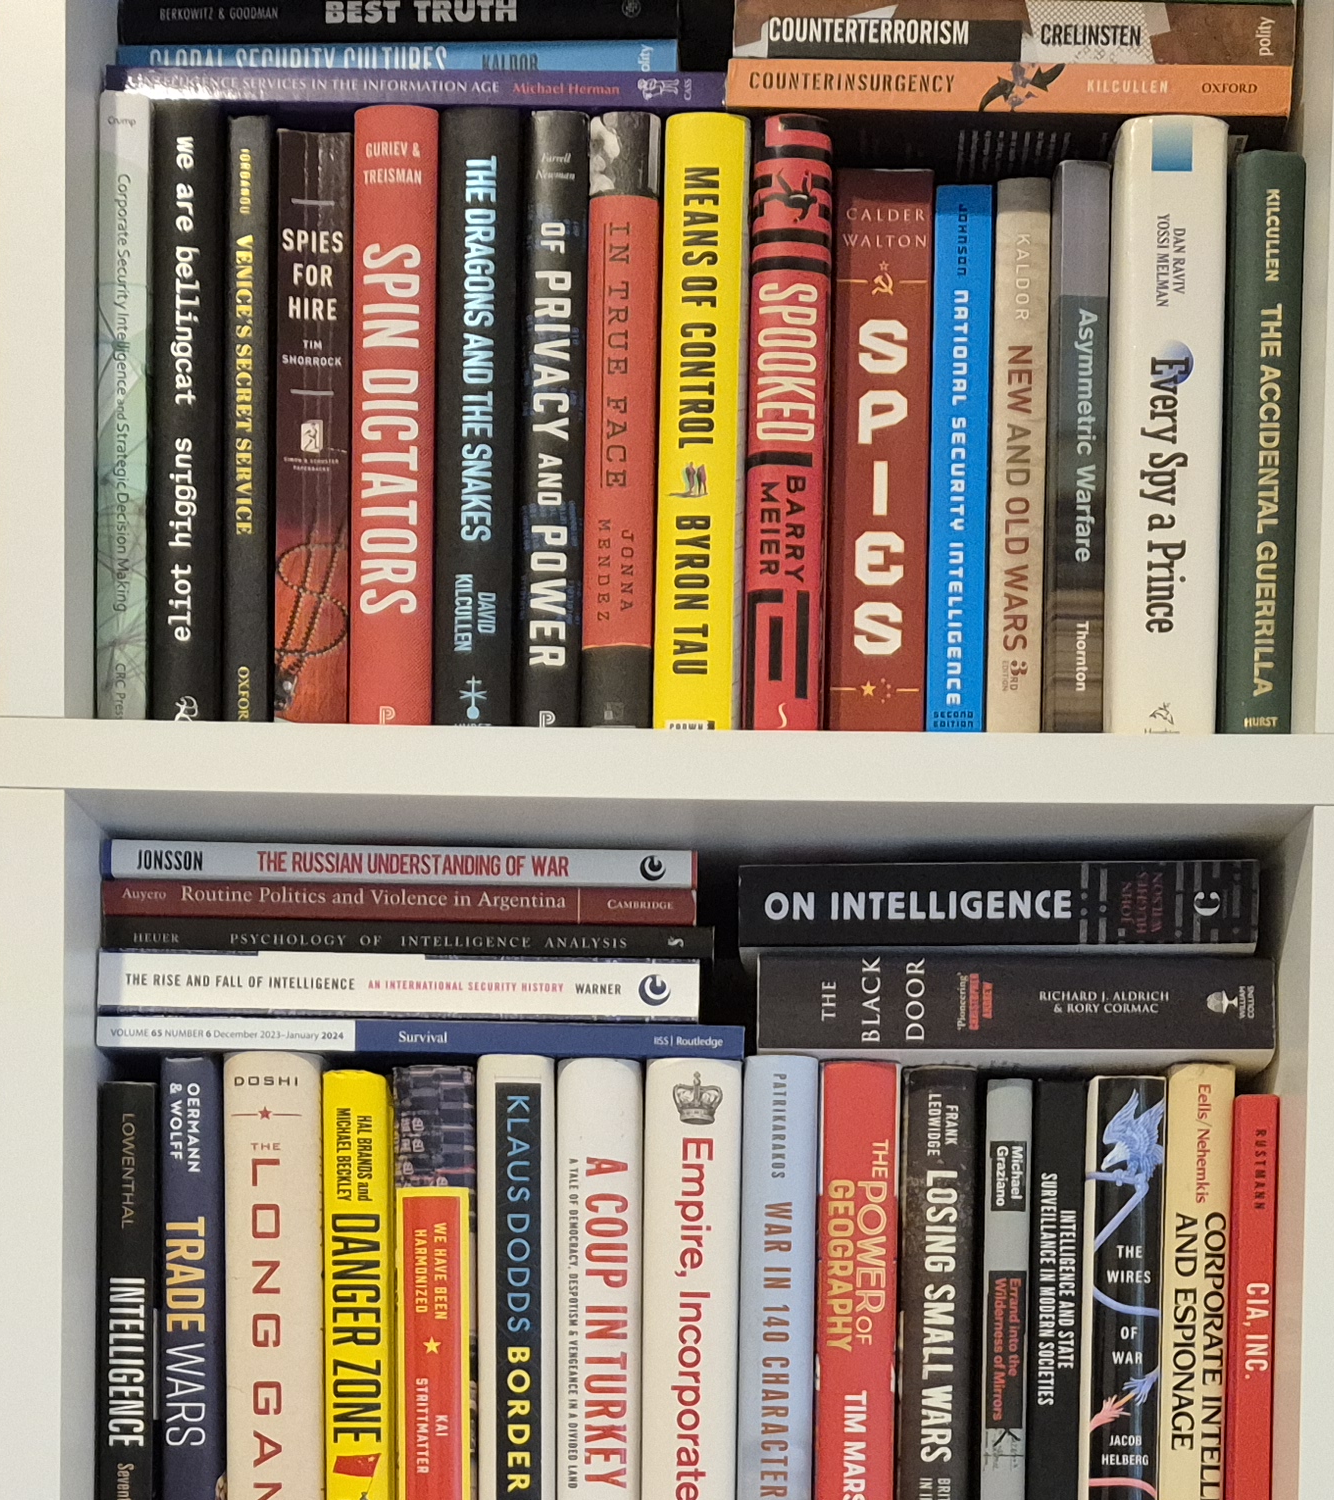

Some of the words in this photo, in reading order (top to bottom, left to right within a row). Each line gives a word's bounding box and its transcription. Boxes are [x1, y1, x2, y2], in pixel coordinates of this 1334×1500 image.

[768, 17, 968, 45] COUNTERTERRORISM
[1041, 24, 1141, 46] CRELINSTEN
[1258, 17, 1275, 56] polity
[750, 72, 954, 92] COUNTERINSURGENCY
[1087, 80, 1167, 93] KILCULLEN
[1202, 83, 1257, 93] OXFORD
[846, 207, 924, 223] CALDER
[283, 229, 343, 253] SPIES
[843, 233, 926, 249] WALTON
[294, 265, 332, 287] FOR
[363, 244, 421, 348] SPIN
[289, 299, 336, 321] HIRE
[360, 369, 418, 614] DICTATORS
[674, 516, 711, 610] BYRON
[673, 624, 708, 675] TAU
[138, 850, 202, 870] JONSSON
[257, 851, 287, 872] THE
[292, 852, 362, 873] RUSSIAN
[368, 853, 501, 876] UNDERSTANDING
[506, 855, 525, 876] OF
[532, 856, 568, 876] WAR
[765, 892, 814, 920] ON
[831, 890, 1071, 920] INTELLIGENCE
[575, 984, 621, 994] WARNER
[399, 1031, 447, 1043] Survival
[234, 1076, 298, 1086] DOSHI
[1110, 1435, 1142, 1447] JACOB
[1102, 1454, 1148, 1467] HELBERG
